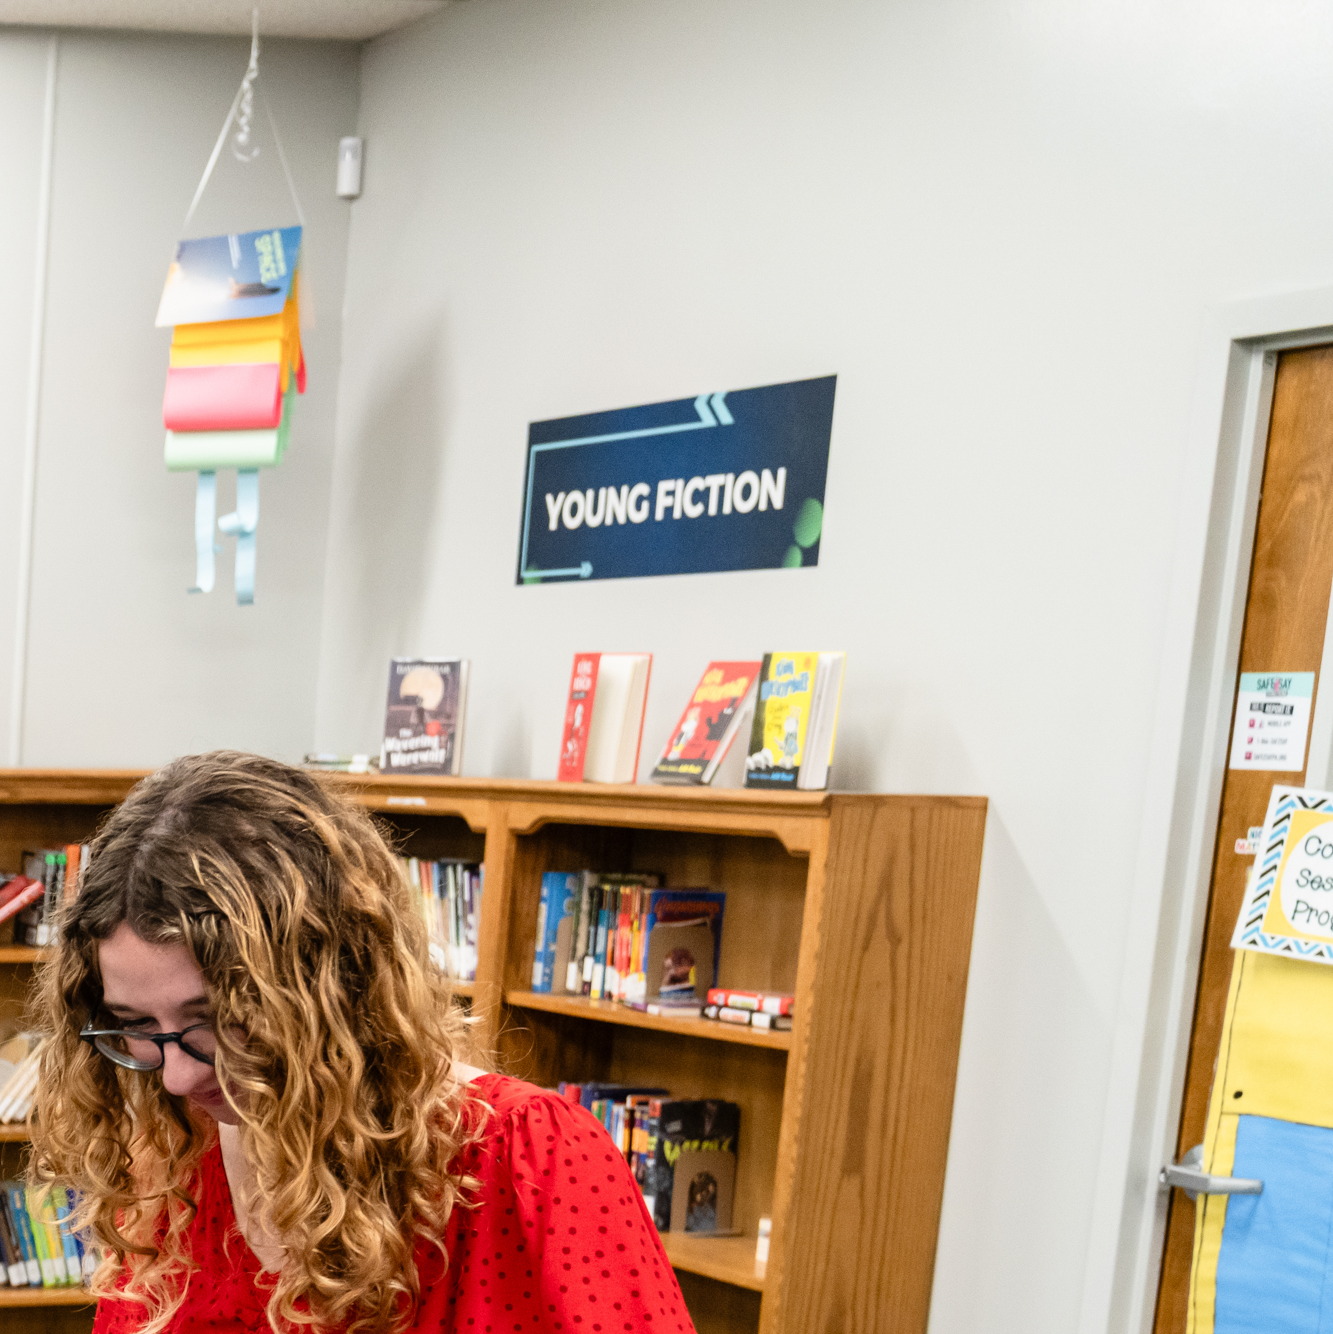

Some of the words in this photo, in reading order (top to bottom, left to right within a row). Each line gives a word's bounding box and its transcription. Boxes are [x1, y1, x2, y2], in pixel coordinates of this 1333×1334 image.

[544, 481, 651, 532] YOUNG
[654, 466, 788, 522] FICTION
[1290, 899, 1333, 932] Pro
